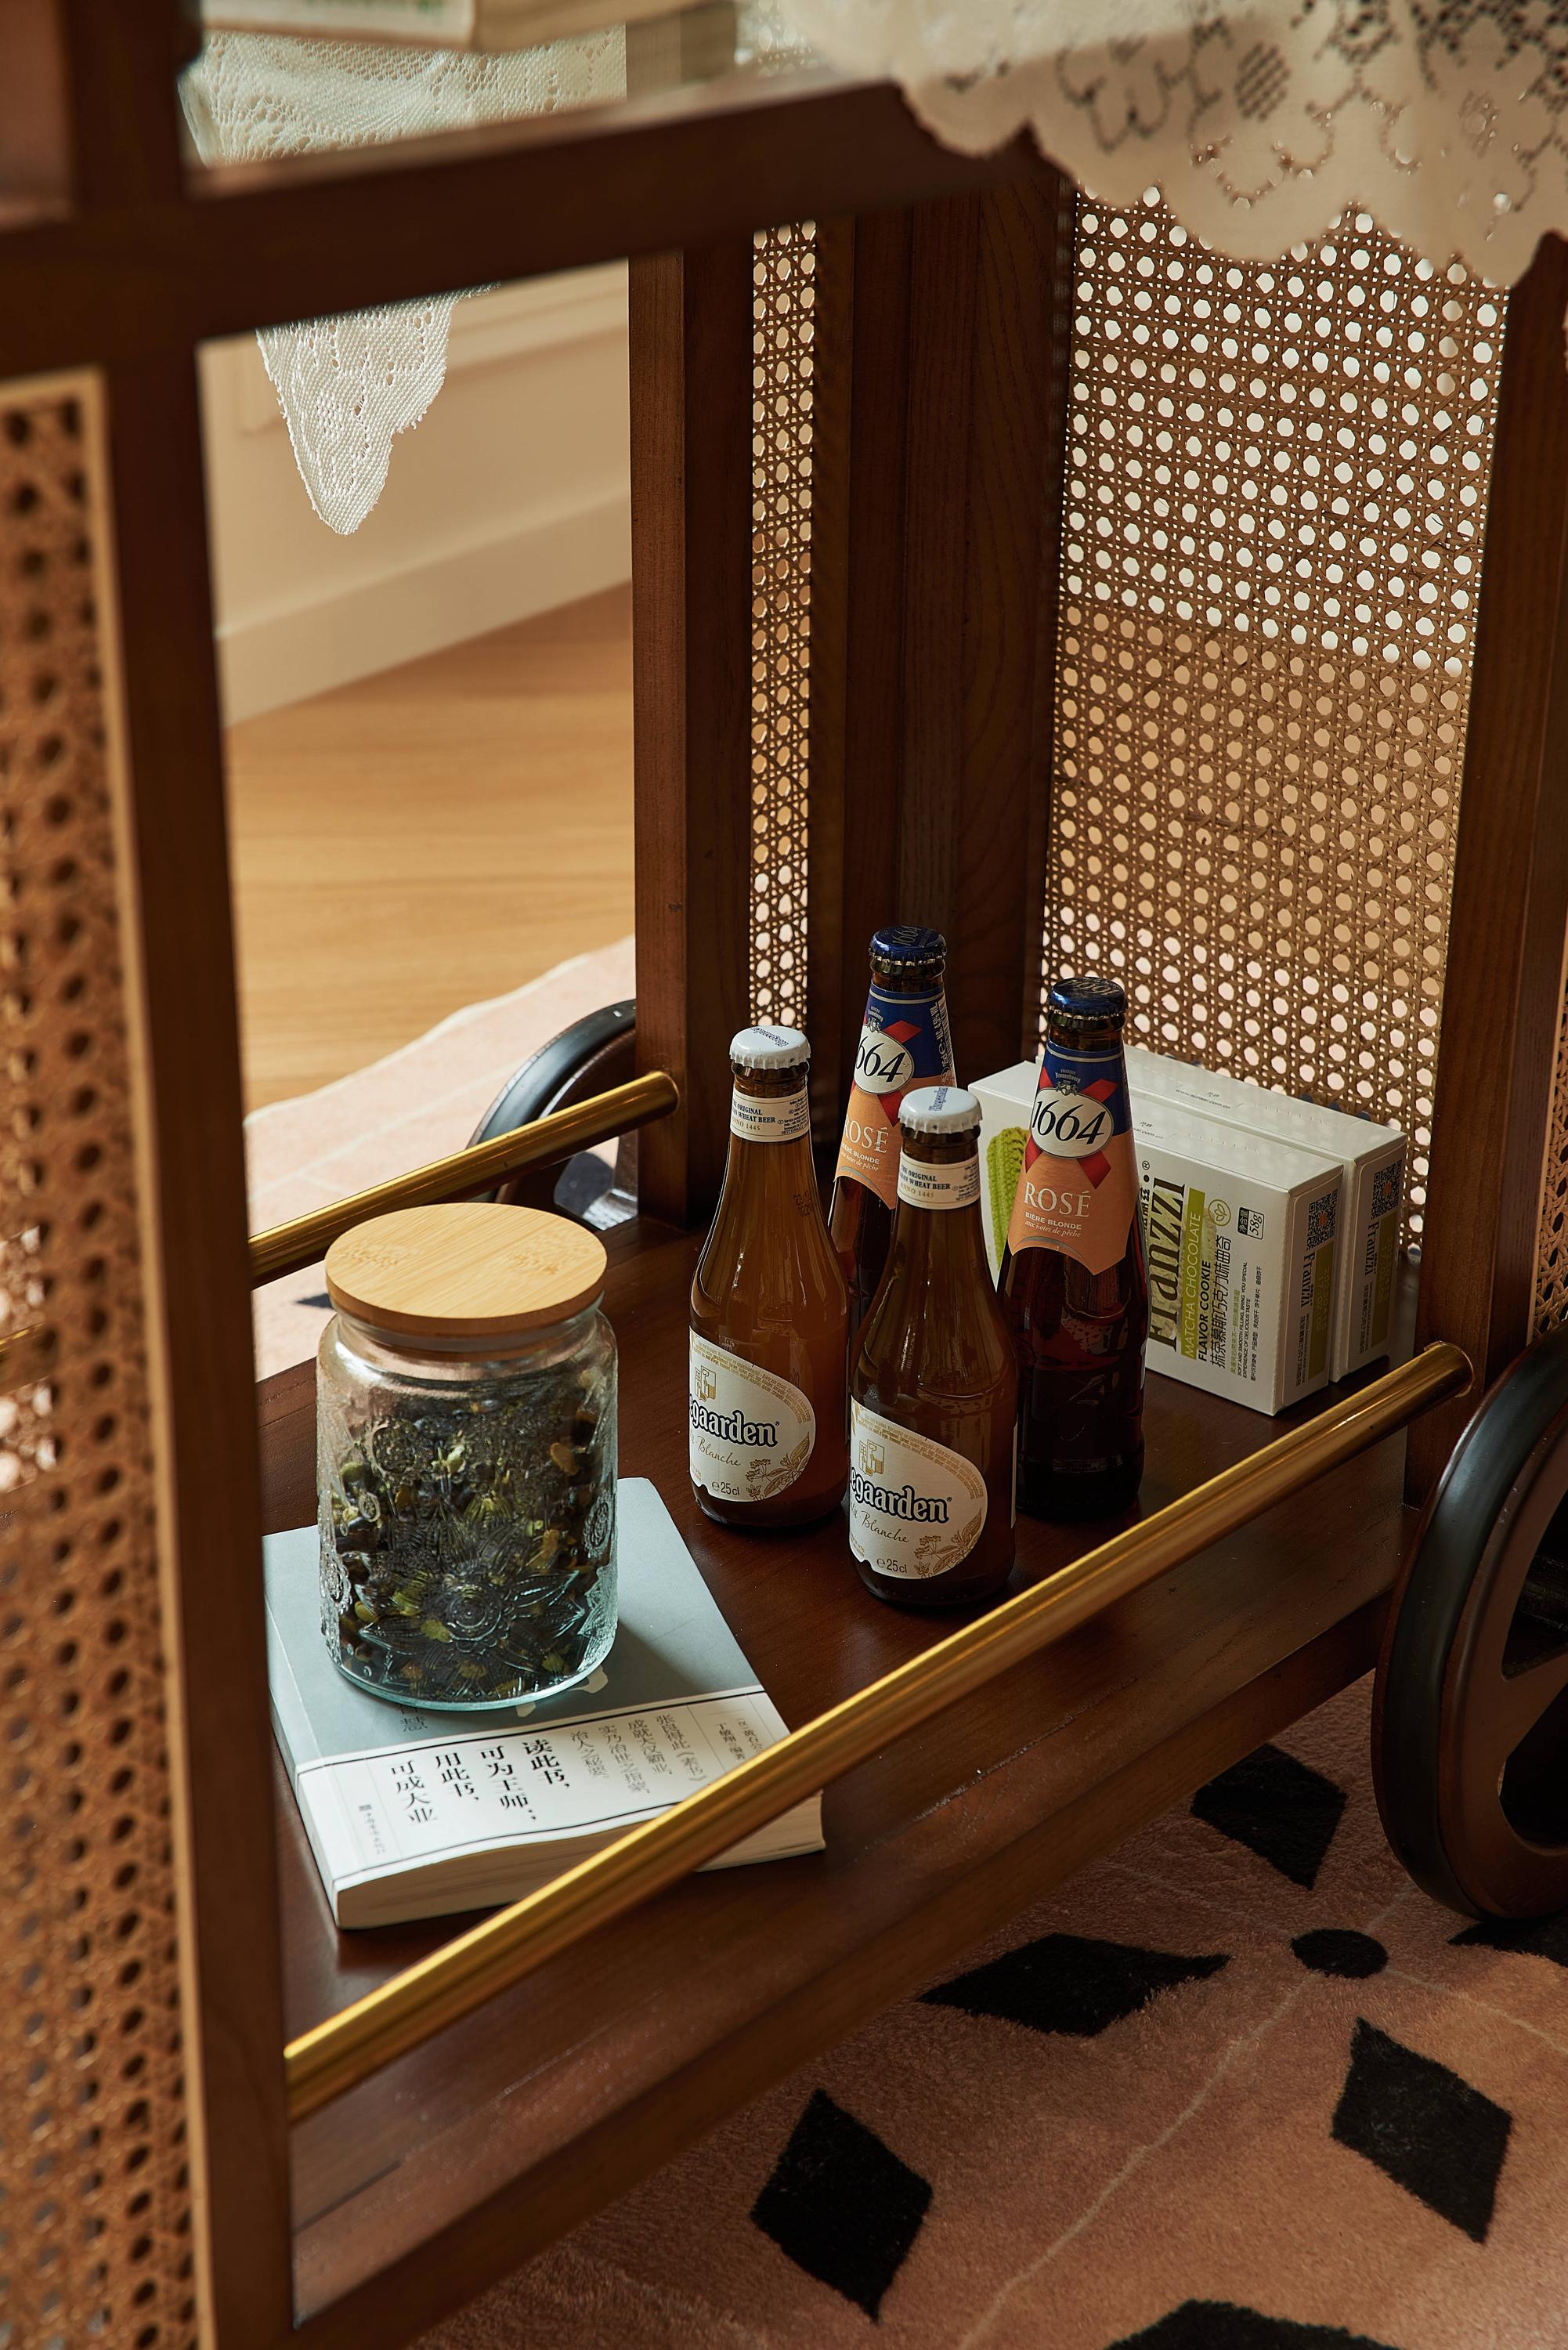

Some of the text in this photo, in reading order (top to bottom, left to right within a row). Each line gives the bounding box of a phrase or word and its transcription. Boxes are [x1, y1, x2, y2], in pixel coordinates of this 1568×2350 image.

[738, 1103, 763, 1115] ORIGINAL
[738, 1111, 757, 1123] WHEAT
[1031, 1100, 1107, 1145] 1664
[746, 1122, 761, 1131] 1445
[853, 1151, 880, 1165] BLONDE
[908, 1170, 938, 1182] ORIGINAL
[909, 1178, 931, 1190] WHEAT
[918, 1189, 934, 1198] 1445
[1024, 1181, 1091, 1217] ROSÉ
[1025, 1212, 1082, 1230] BIÈRE BLONDE
[1035, 1223, 1052, 1232] notes
[1239, 1209, 1248, 1233] 净含量
[1249, 1213, 1263, 1236] 58g
[1365, 1220, 1380, 1276] Franzzi
[1184, 1212, 1201, 1358] MATCHA CHOCOLATE
[1301, 1252, 1316, 1311] Franzzi
[1198, 1260, 1211, 1361] FLAVOR COOKIE
[1210, 1235, 1232, 1369] 抹茶慕斯巧克力味曲奇
[697, 1435, 741, 1466] Blanche
[861, 1510, 909, 1542] Blanche
[435, 1752, 479, 1801] 用此书，
[522, 1738, 570, 1789] 读此书，
[387, 1760, 439, 1824] 可成大业
[476, 1745, 537, 1820] 可为王师；
